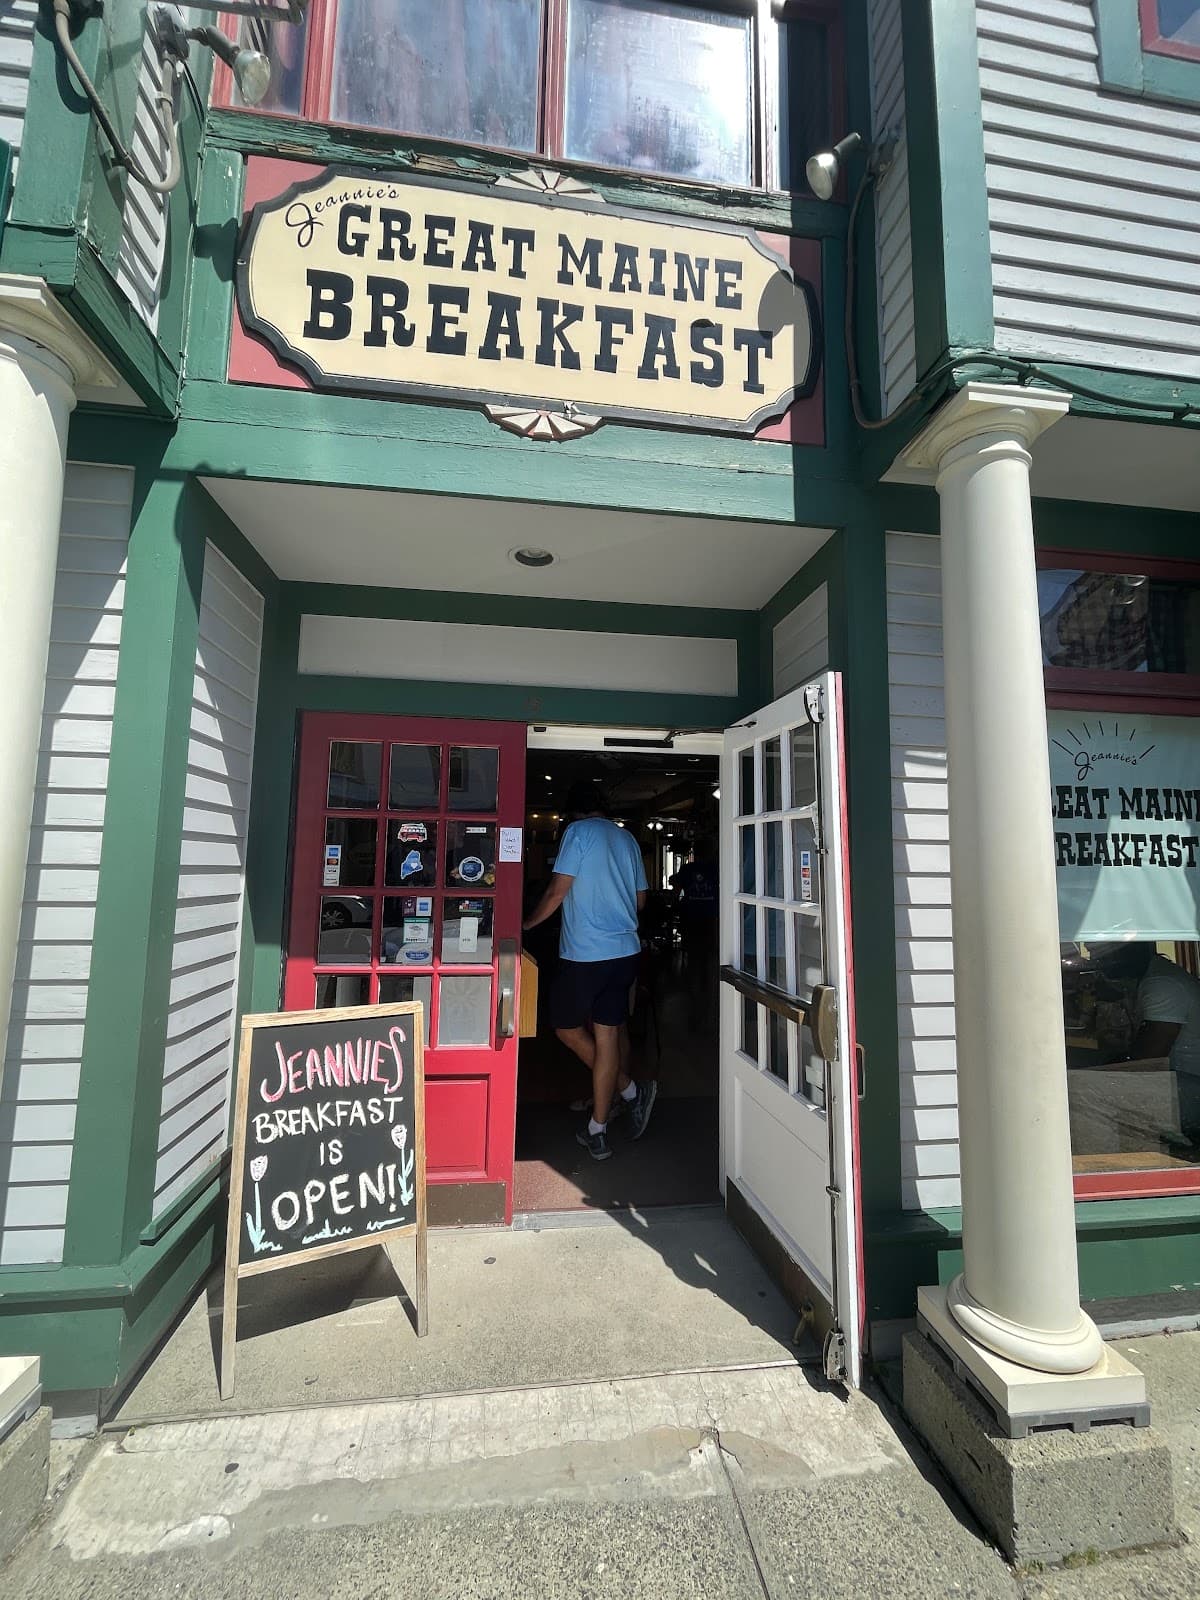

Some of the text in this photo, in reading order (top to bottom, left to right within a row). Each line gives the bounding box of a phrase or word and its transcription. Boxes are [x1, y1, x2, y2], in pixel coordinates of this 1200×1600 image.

[285, 184, 399, 248] Jeannie's
[337, 203, 744, 310] GREAT MAINE
[302, 268, 774, 395] BREAKFAST
[1074, 751, 1137, 781] Jeannie's
[260, 1026, 406, 1103] JEANNIES
[252, 1097, 403, 1144] BREAKFAST
[319, 1139, 344, 1166] IS
[271, 1162, 397, 1231] OPEN!
